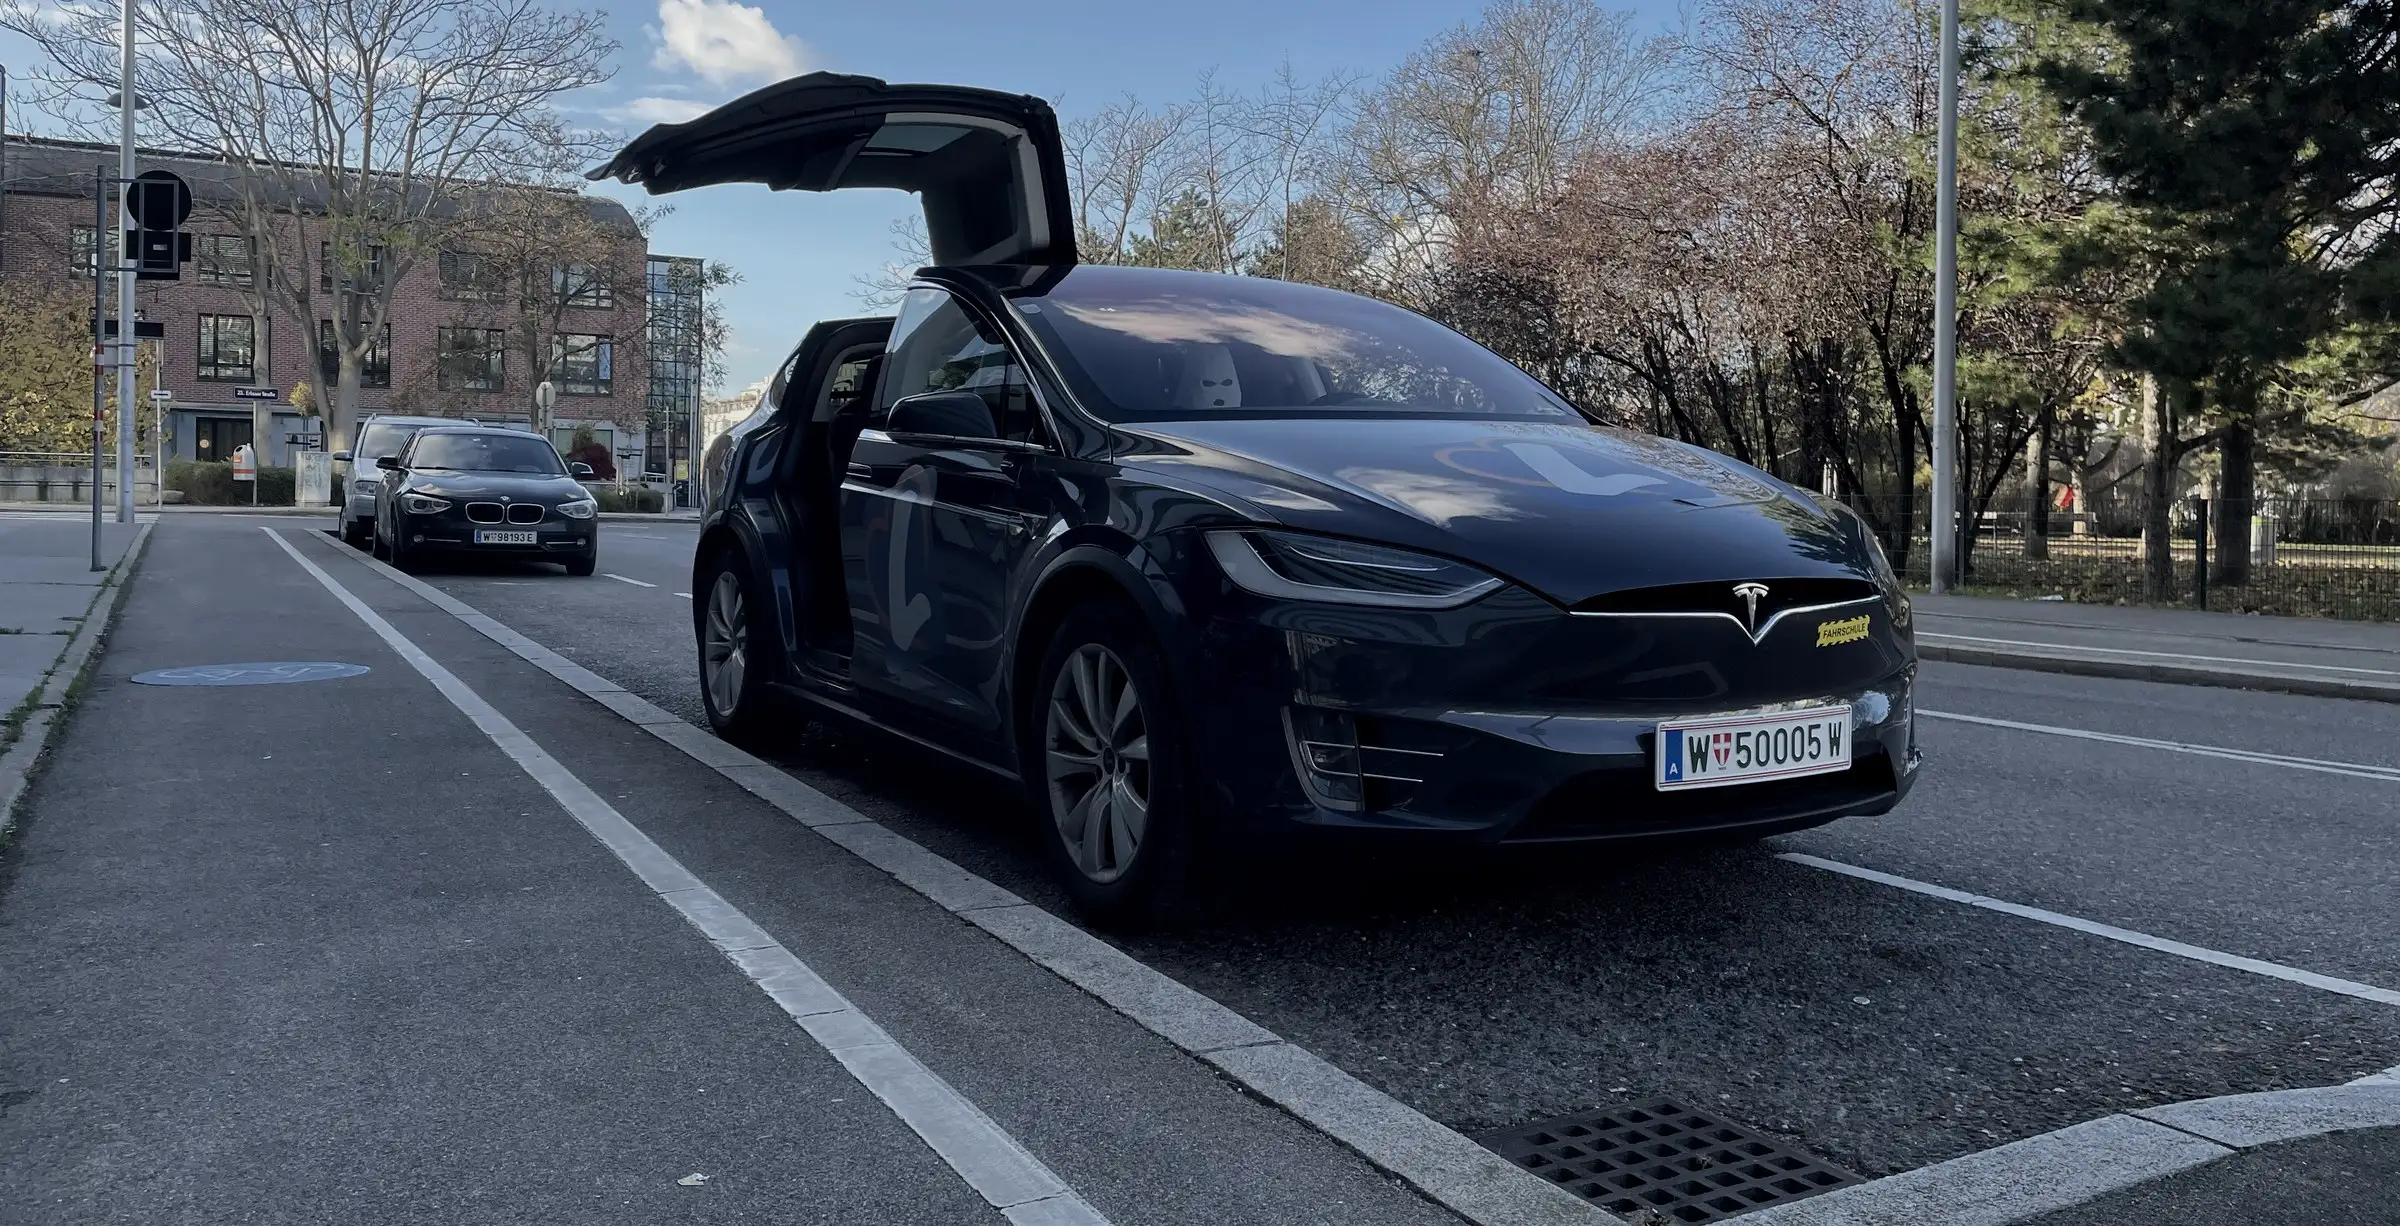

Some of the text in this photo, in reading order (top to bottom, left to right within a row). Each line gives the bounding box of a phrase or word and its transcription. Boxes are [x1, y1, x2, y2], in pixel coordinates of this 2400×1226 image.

[497, 532, 525, 542] 98193
[1822, 622, 1866, 640] FAHRSCHULE
[1688, 720, 1843, 774] W 50005 W
[1669, 762, 1679, 775] A
